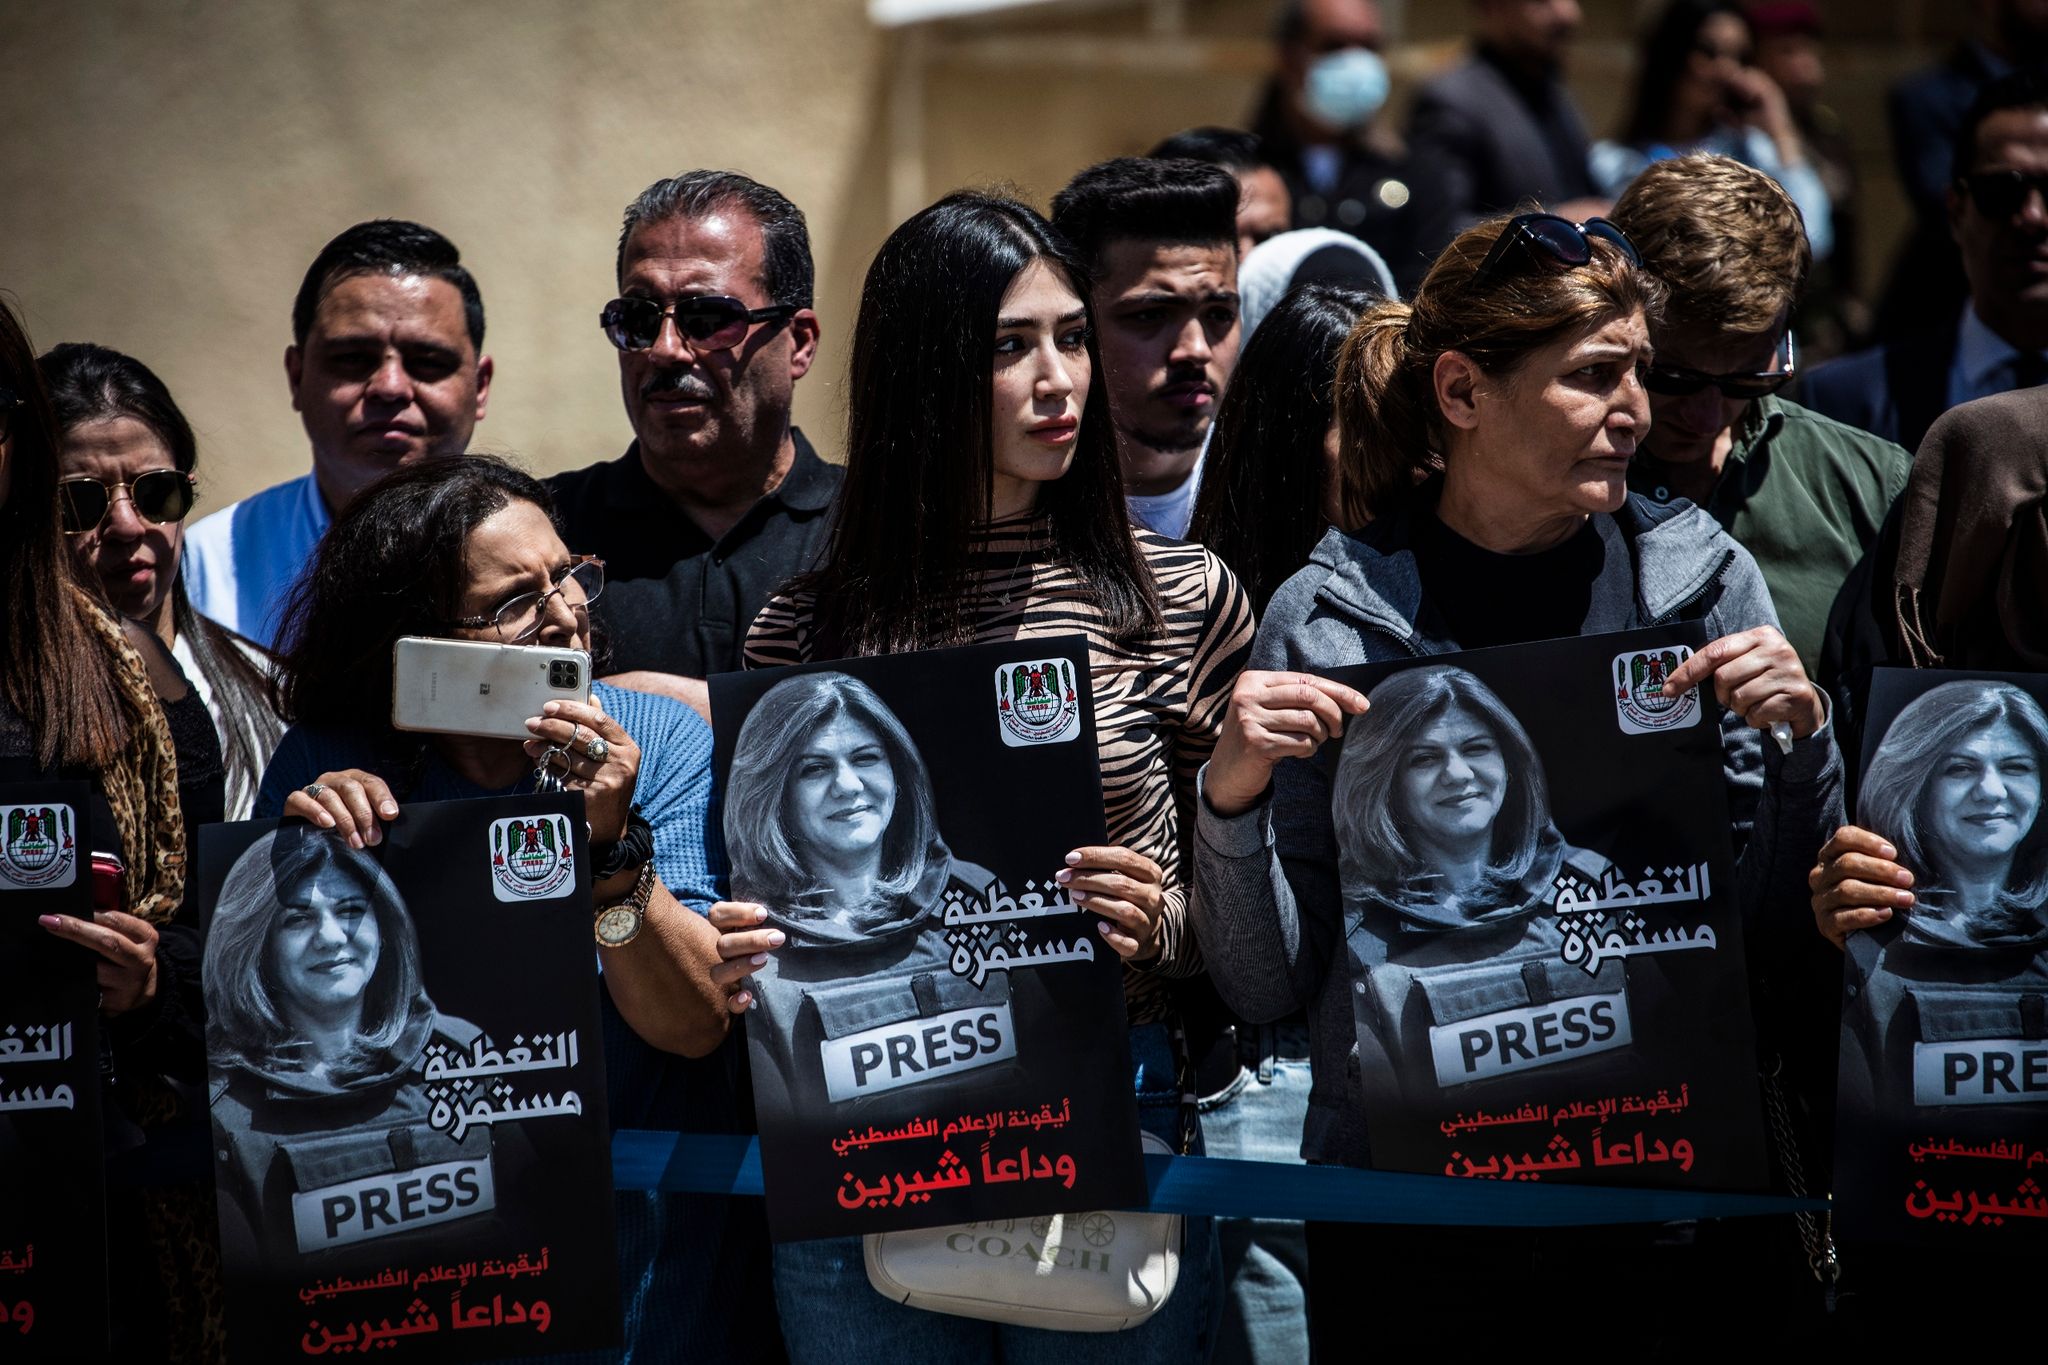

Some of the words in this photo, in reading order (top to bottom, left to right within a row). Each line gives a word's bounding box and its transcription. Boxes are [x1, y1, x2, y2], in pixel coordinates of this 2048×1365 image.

[944, 879, 1087, 936] لتغطية
[1556, 861, 1711, 925] التغطية
[948, 930, 1095, 987] مستمرة
[1560, 918, 1717, 973] مستمرة
[0, 1021, 73, 1062] التغ
[850, 1013, 1001, 1087] PRESS
[1459, 1001, 1616, 1073] PRESS
[425, 1029, 578, 1091] التغطية
[1944, 1051, 2048, 1096] PRE
[428, 1084, 582, 1141] مستمرة
[1008, 1098, 1070, 1131] أيقونة
[1440, 1103, 1548, 1137] الفلسطيني
[1553, 1098, 1616, 1127] الإعلام
[1622, 1083, 1689, 1116] أيقونة
[831, 1116, 938, 1157] الفلسطيني
[943, 1112, 1003, 1144] الإعلام
[1908, 1137, 2024, 1163] الفلسطيني
[837, 1149, 971, 1210] شيرين
[1445, 1134, 1581, 1181] شيرين
[322, 1167, 481, 1239] PRESS
[482, 1247, 549, 1279] أيقونة
[946, 1232, 1111, 1273] COACH
[299, 1267, 409, 1305] الفلسطيني
[413, 1262, 477, 1291] الإعلام
[302, 1298, 439, 1355] شيرين
